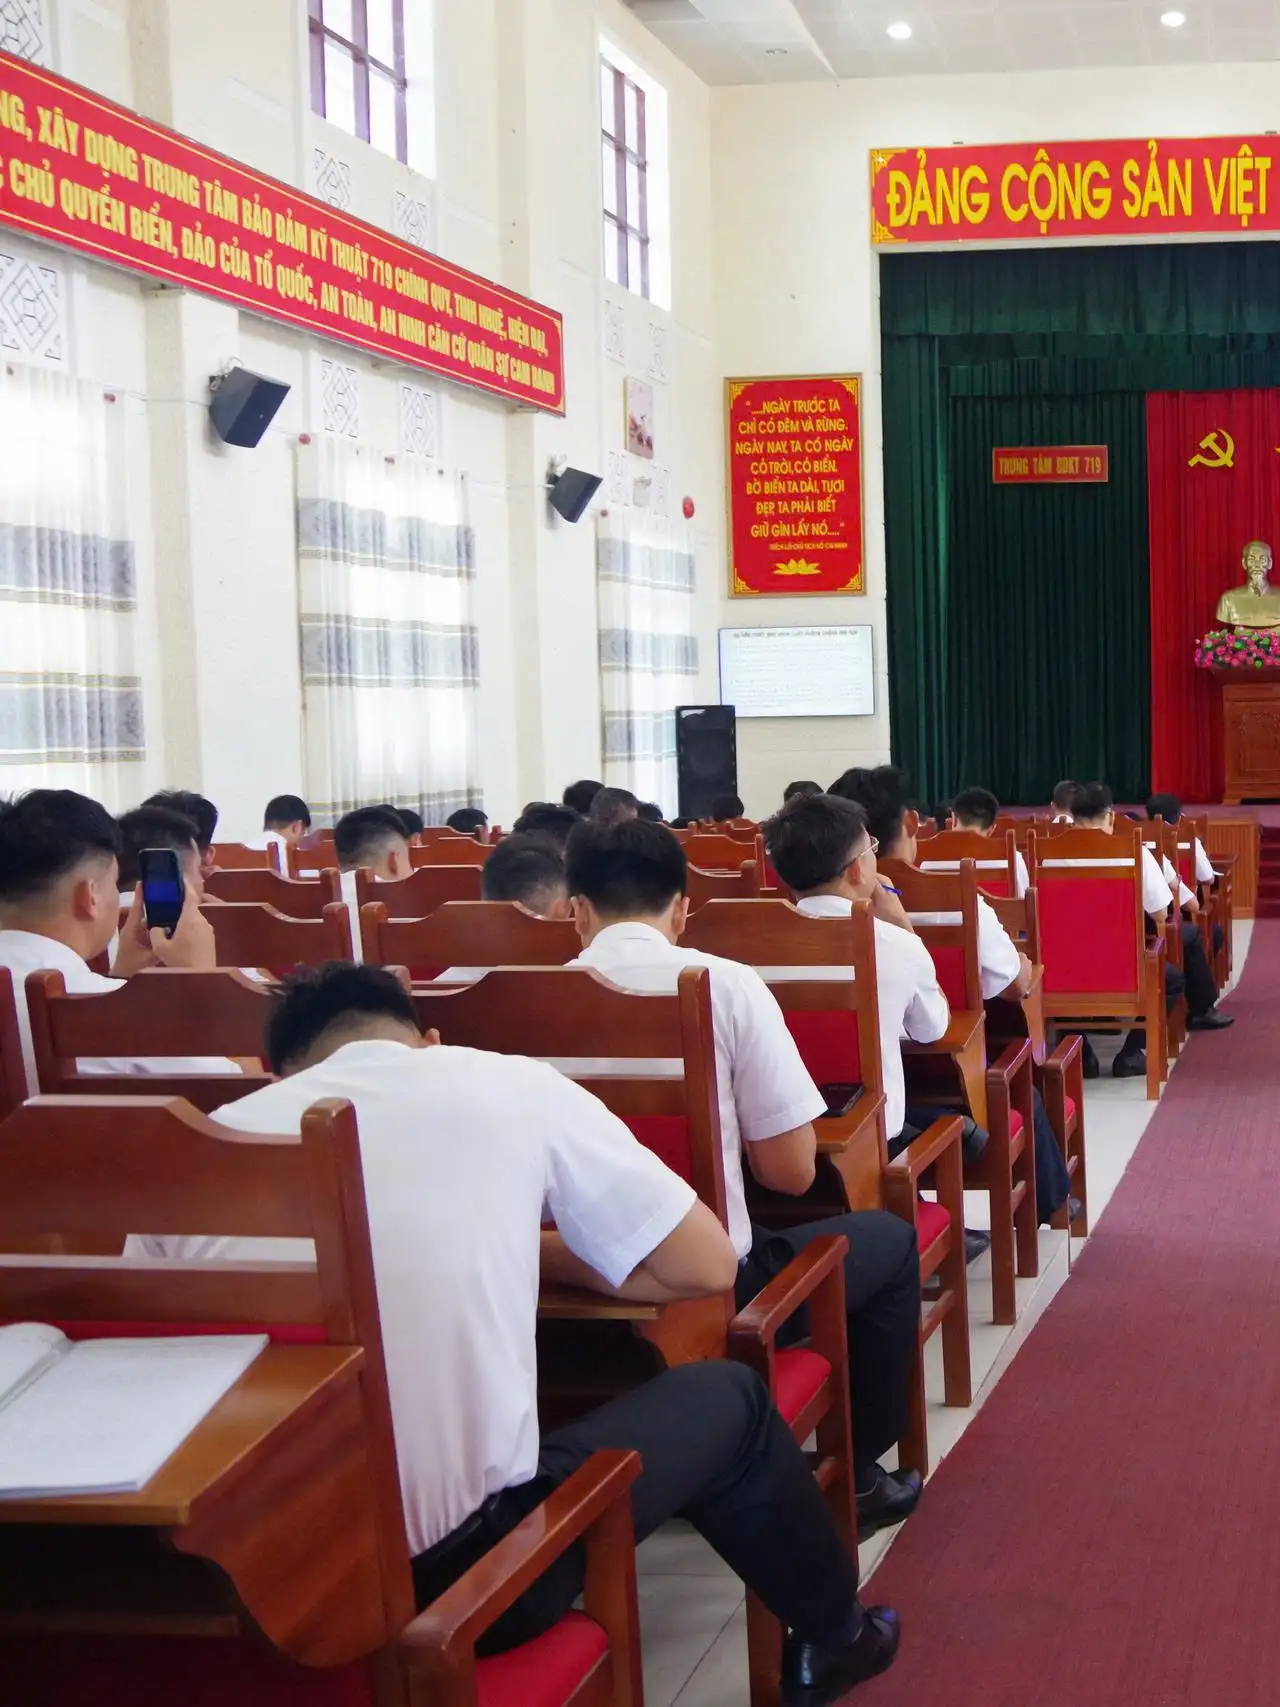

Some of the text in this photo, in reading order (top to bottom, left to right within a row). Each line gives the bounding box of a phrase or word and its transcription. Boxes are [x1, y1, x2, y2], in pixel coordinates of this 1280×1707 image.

[9, 158, 55, 208] CHỦ
[60, 178, 126, 236] QUYỀN
[129, 202, 178, 259] BIỂN,
[181, 220, 216, 269] ĐẢO
[220, 236, 252, 283] CỦA
[254, 249, 273, 289] TỔ
[276, 262, 318, 311] QUỐC,
[321, 282, 339, 315] AN
[341, 290, 378, 333] TOÀN,
[380, 305, 396, 337] AN
[36, 105, 79, 156] XÂY
[84, 127, 139, 183] DỰNG
[141, 153, 200, 209] TRUNG
[202, 179, 238, 225] TÂM
[242, 192, 272, 238] BẢO
[275, 208, 308, 254] ĐẢM
[310, 227, 327, 262] KỸ
[330, 237, 368, 282] THUẬT
[370, 256, 393, 289] 719
[886, 148, 990, 227] ĐẢNG
[1001, 148, 1112, 234] CỘNG
[1122, 139, 1192, 218] SẢN
[1203, 144, 1271, 227] VIỆT
[1085, 456, 1102, 473] 719
